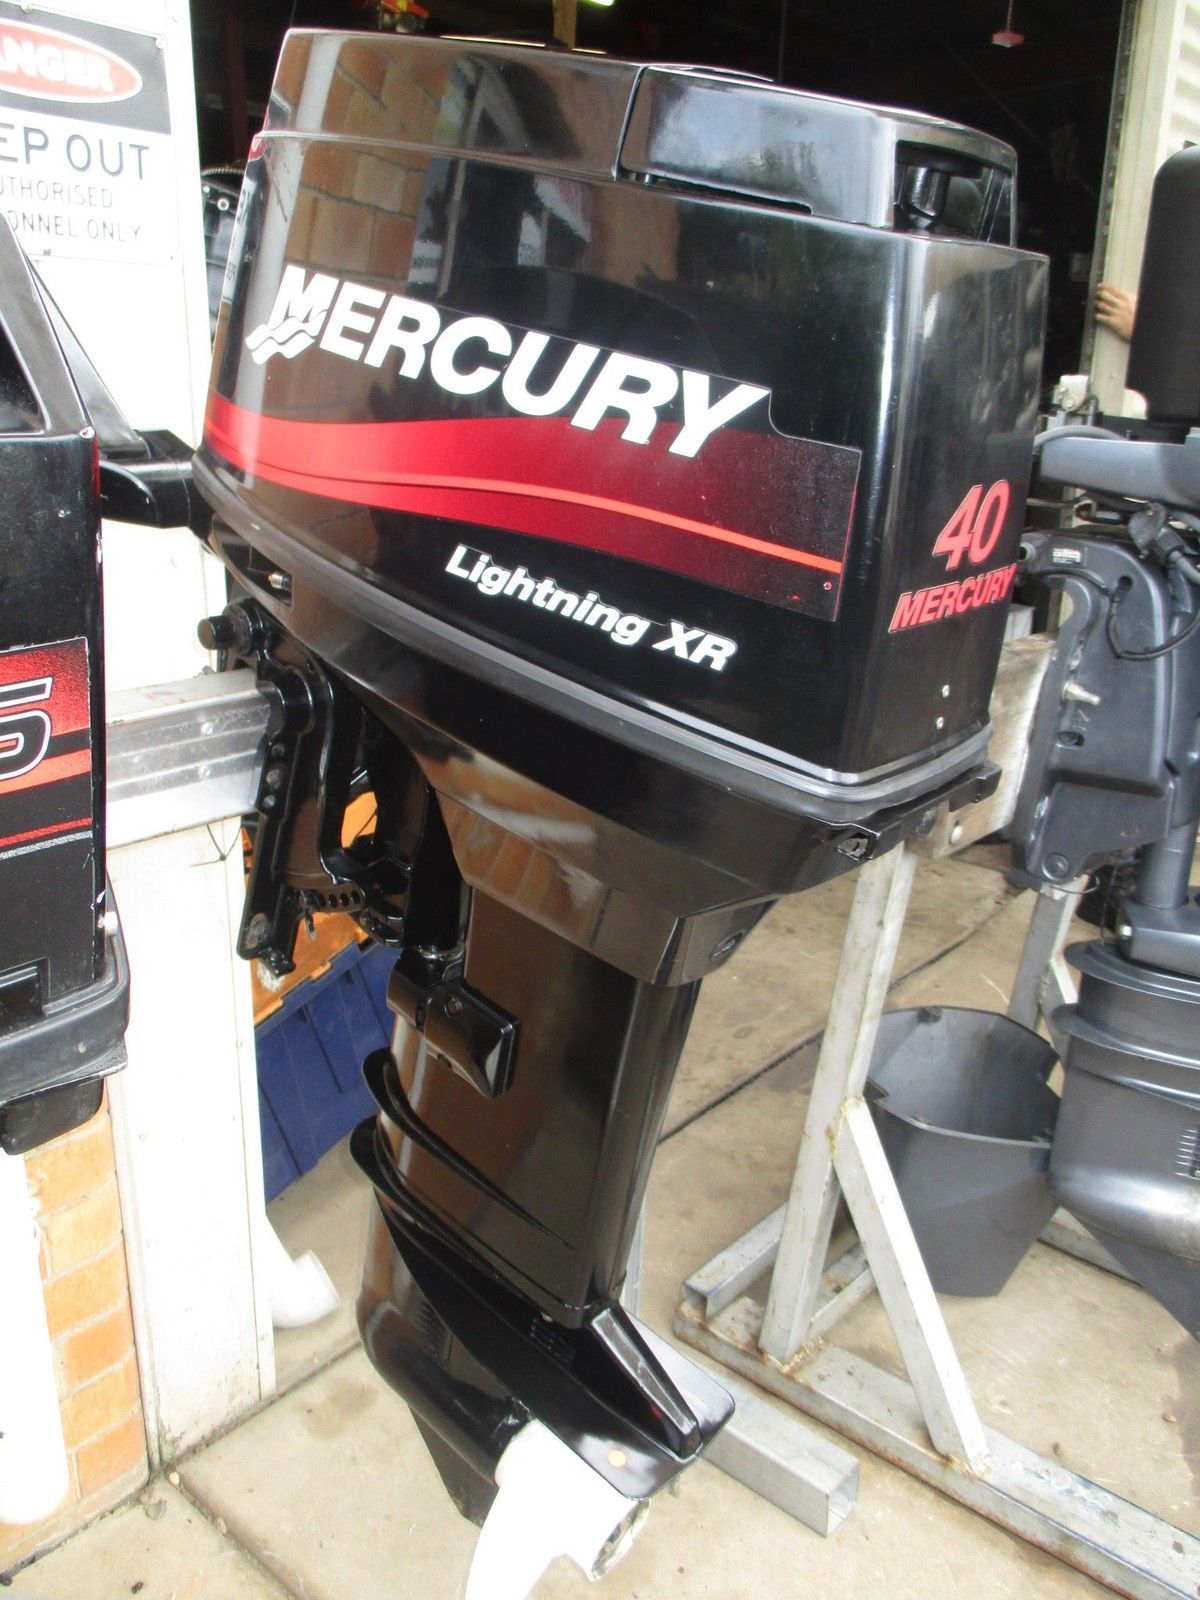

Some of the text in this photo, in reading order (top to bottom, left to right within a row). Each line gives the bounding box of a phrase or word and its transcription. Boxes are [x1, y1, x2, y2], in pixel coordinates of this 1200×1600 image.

[0, 37, 113, 92] NGER
[66, 134, 149, 180] OUT
[87, 218, 144, 242] ONLY
[246, 264, 771, 458] MERCURY
[932, 479, 1012, 571] 40
[444, 543, 738, 673] Lightning XR
[888, 564, 1018, 634] MERCURY
